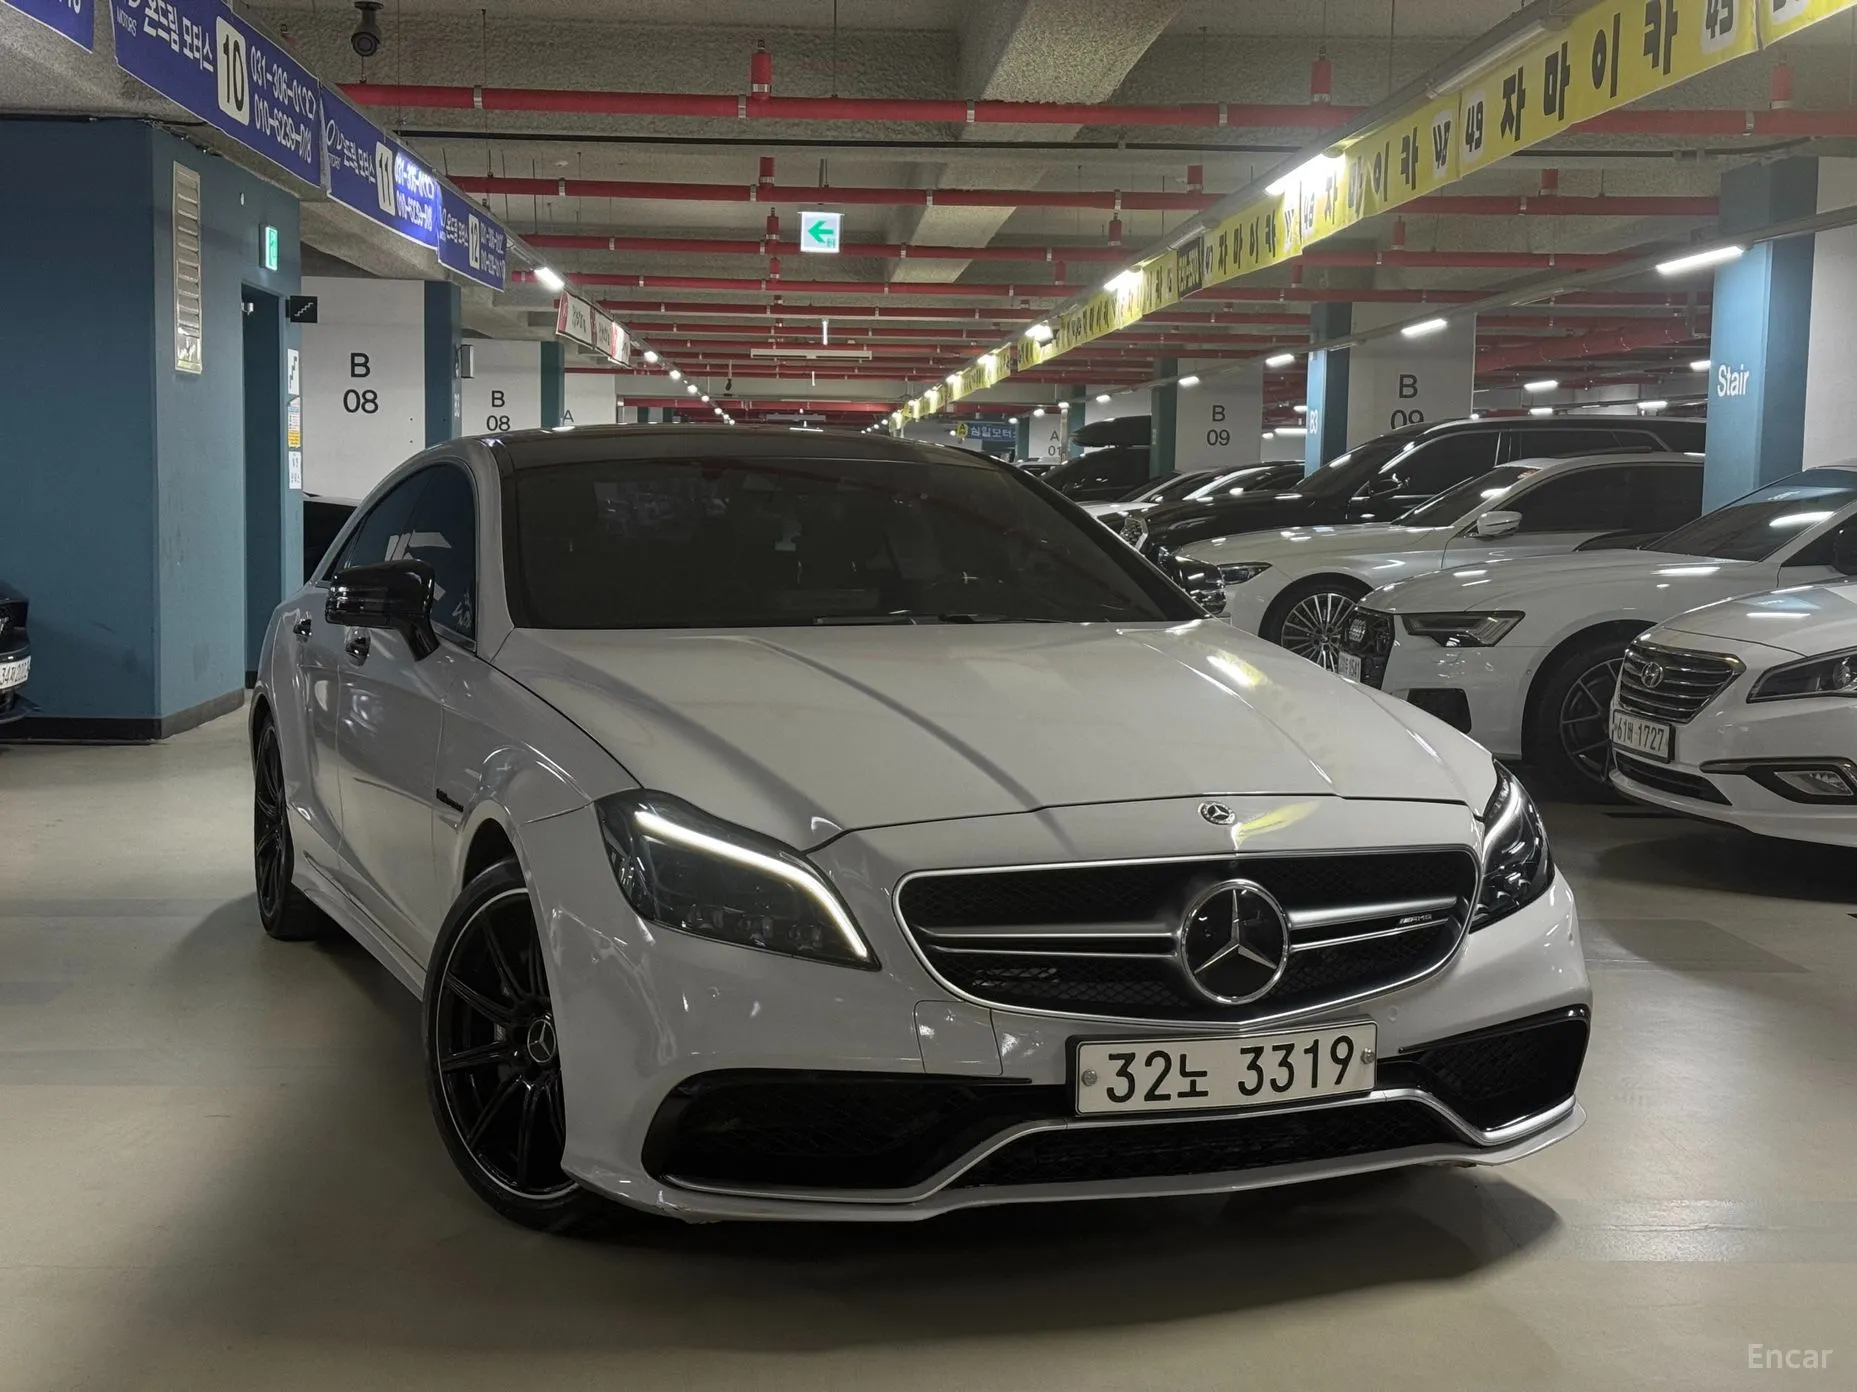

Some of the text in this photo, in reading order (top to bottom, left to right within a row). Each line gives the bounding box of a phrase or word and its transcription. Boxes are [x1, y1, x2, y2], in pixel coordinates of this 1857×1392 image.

[116, 7, 138, 37] MOTORS
[182, 16, 214, 72] 모터스
[223, 34, 244, 112] 10
[1465, 100, 1483, 153] 49
[379, 153, 392, 207] 11
[350, 353, 371, 378] B
[1399, 374, 1418, 398] B
[1717, 363, 1750, 397] Stair
[343, 389, 378, 413] 08
[492, 391, 505, 407] B
[486, 416, 510, 431] 08
[562, 409, 574, 423] A
[1212, 405, 1226, 421] B
[1206, 429, 1230, 446] 09
[1638, 723, 1665, 752] 1727
[1106, 1034, 1355, 1103] 32노 3319
